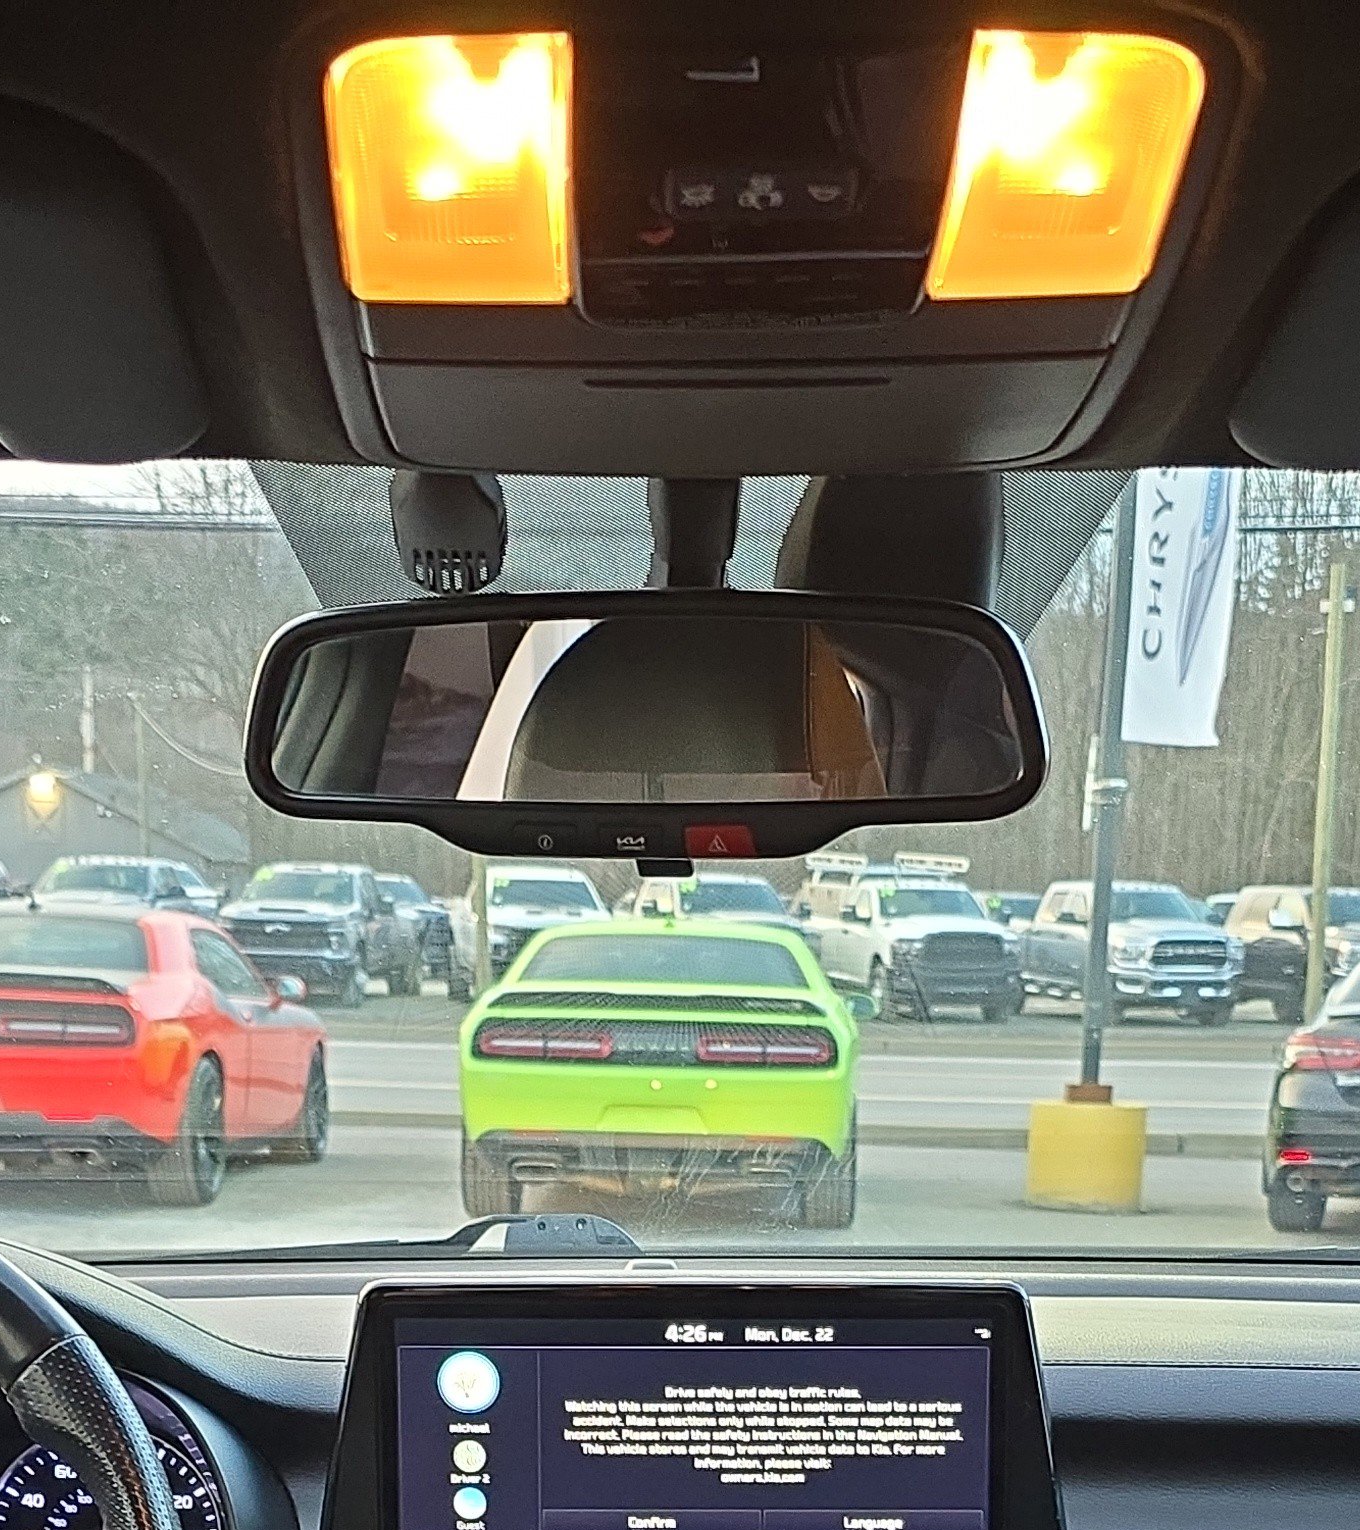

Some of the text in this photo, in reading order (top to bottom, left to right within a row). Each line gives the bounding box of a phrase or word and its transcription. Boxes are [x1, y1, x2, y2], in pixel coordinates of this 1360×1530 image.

[665, 1324, 707, 1342] 4:26
[815, 1327, 833, 1341] 22
[20, 1493, 45, 1508] 40
[456, 1520, 486, 1530] Guest
[627, 1516, 676, 1529] Confirm
[843, 1516, 904, 1530] Language
